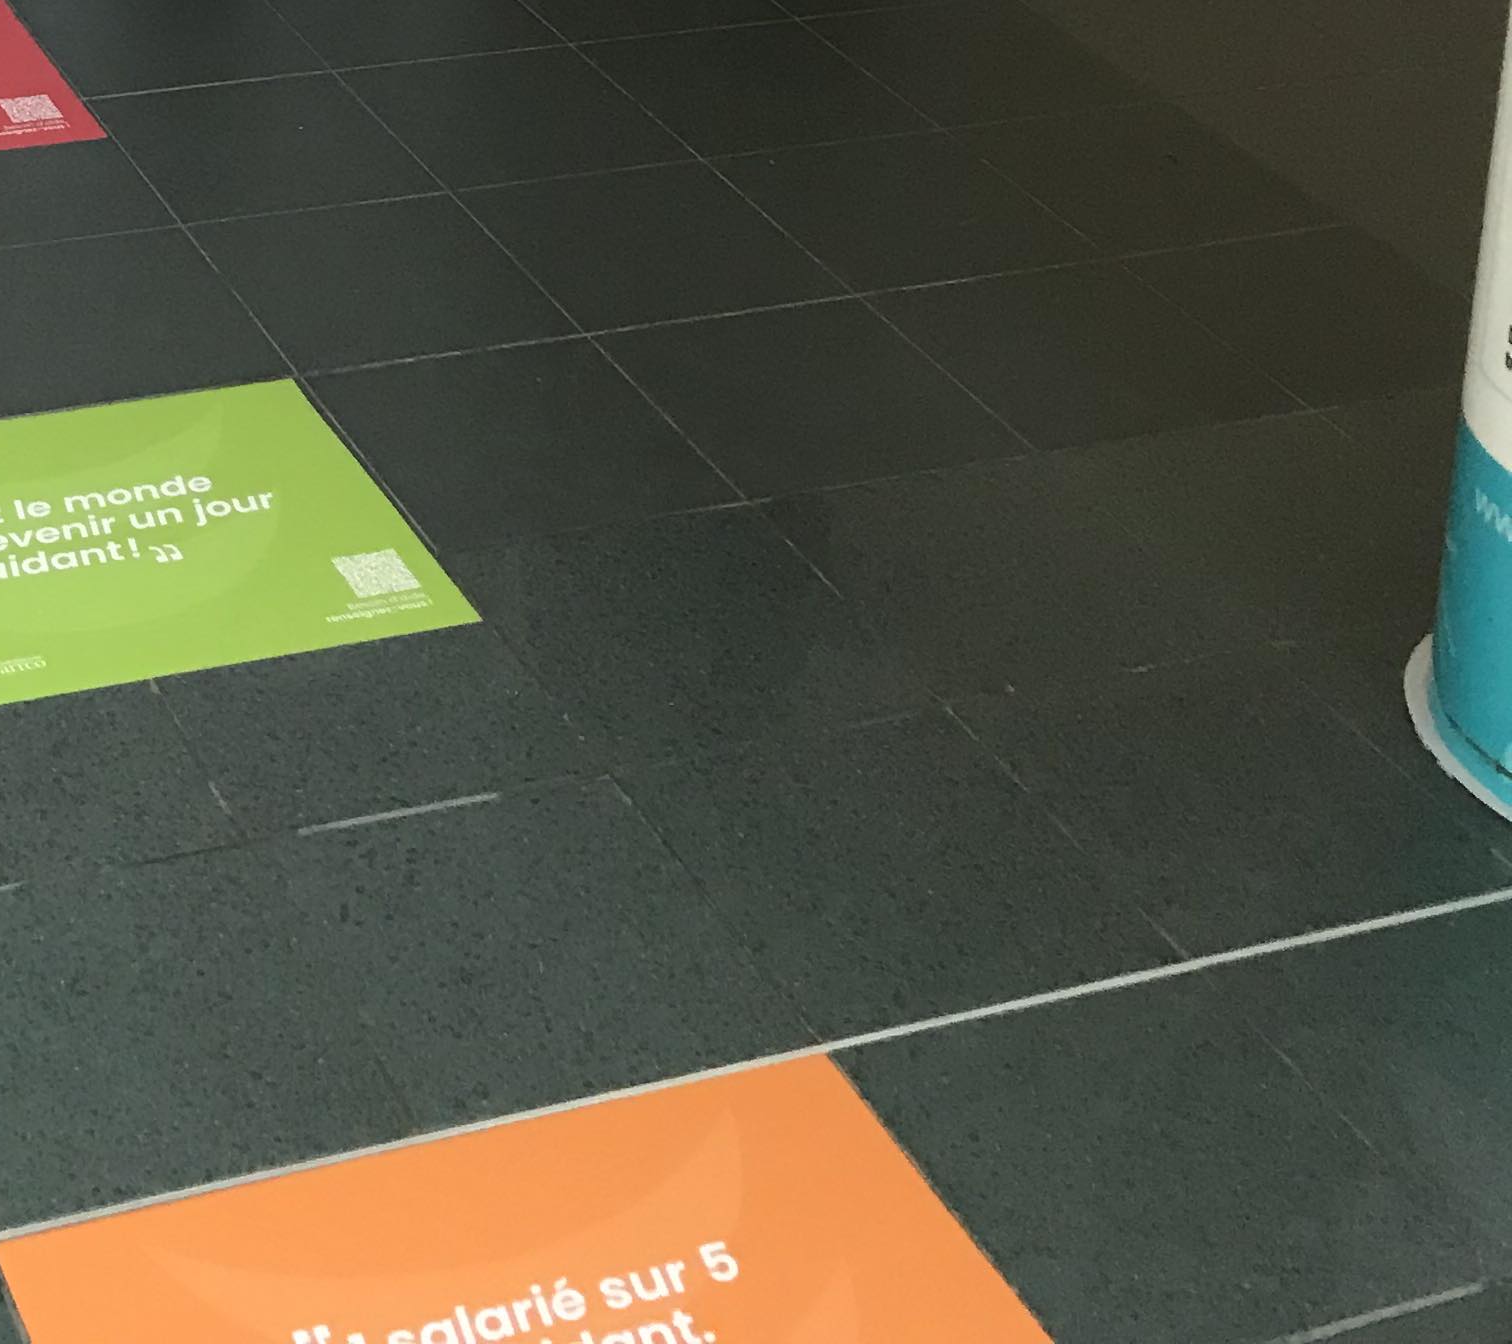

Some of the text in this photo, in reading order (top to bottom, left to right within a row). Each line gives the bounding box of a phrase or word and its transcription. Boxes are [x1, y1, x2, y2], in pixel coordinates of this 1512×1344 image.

[14, 499, 52, 521] le
[63, 474, 214, 514] monde
[129, 505, 184, 531] un
[192, 489, 275, 528] jour
[599, 1259, 686, 1310] sur
[699, 1240, 740, 1283] 5
